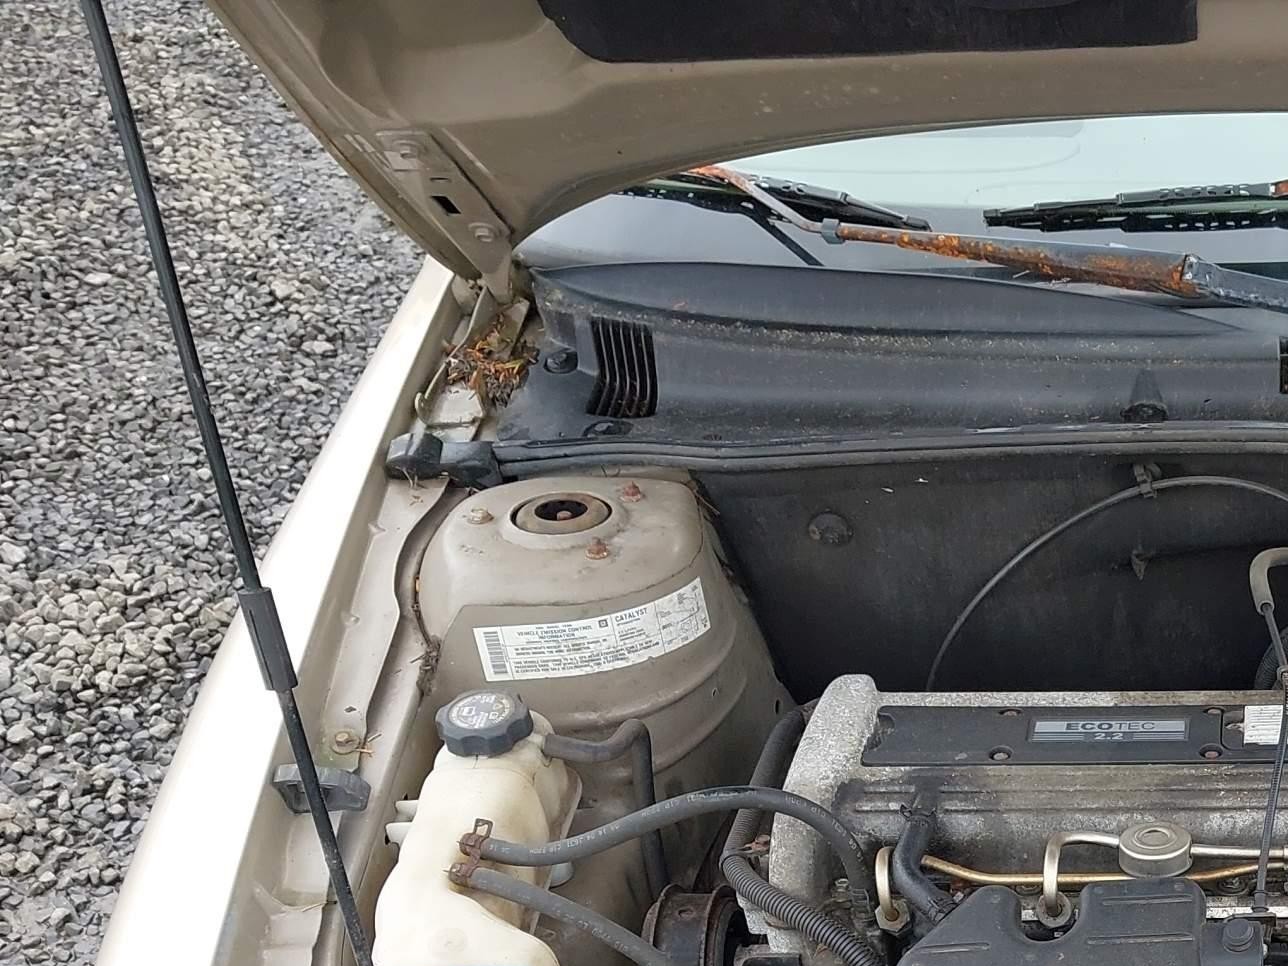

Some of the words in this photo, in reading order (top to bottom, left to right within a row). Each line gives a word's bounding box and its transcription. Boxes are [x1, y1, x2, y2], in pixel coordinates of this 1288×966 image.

[614, 607, 648, 622] CATALYST
[1065, 721, 1156, 732] ECOTEC
[1094, 732, 1124, 741] 2.2
